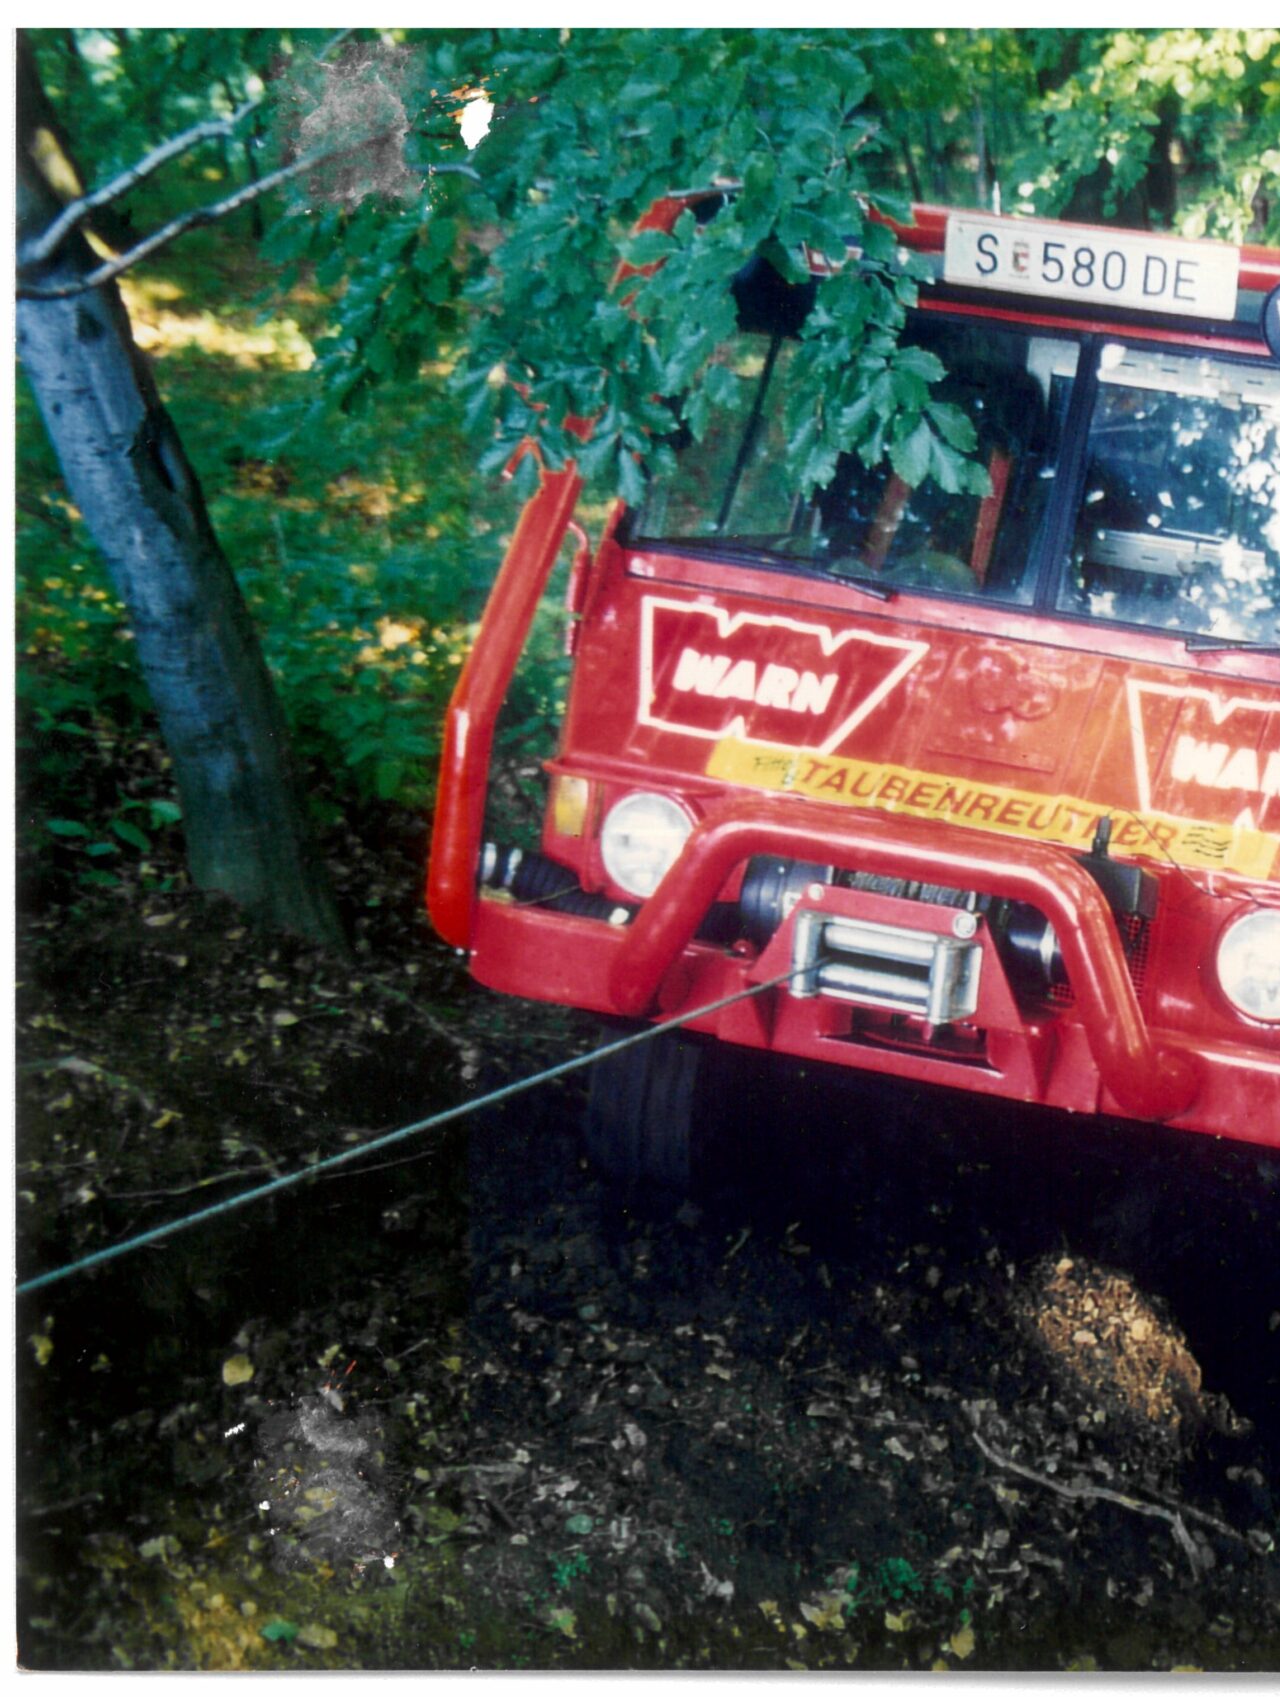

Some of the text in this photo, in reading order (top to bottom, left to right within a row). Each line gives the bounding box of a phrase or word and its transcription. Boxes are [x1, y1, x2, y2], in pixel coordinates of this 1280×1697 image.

[975, 233, 1200, 301] S 580 DE
[673, 647, 839, 715] WARN
[801, 759, 1181, 850] TAUBENREUTHER
